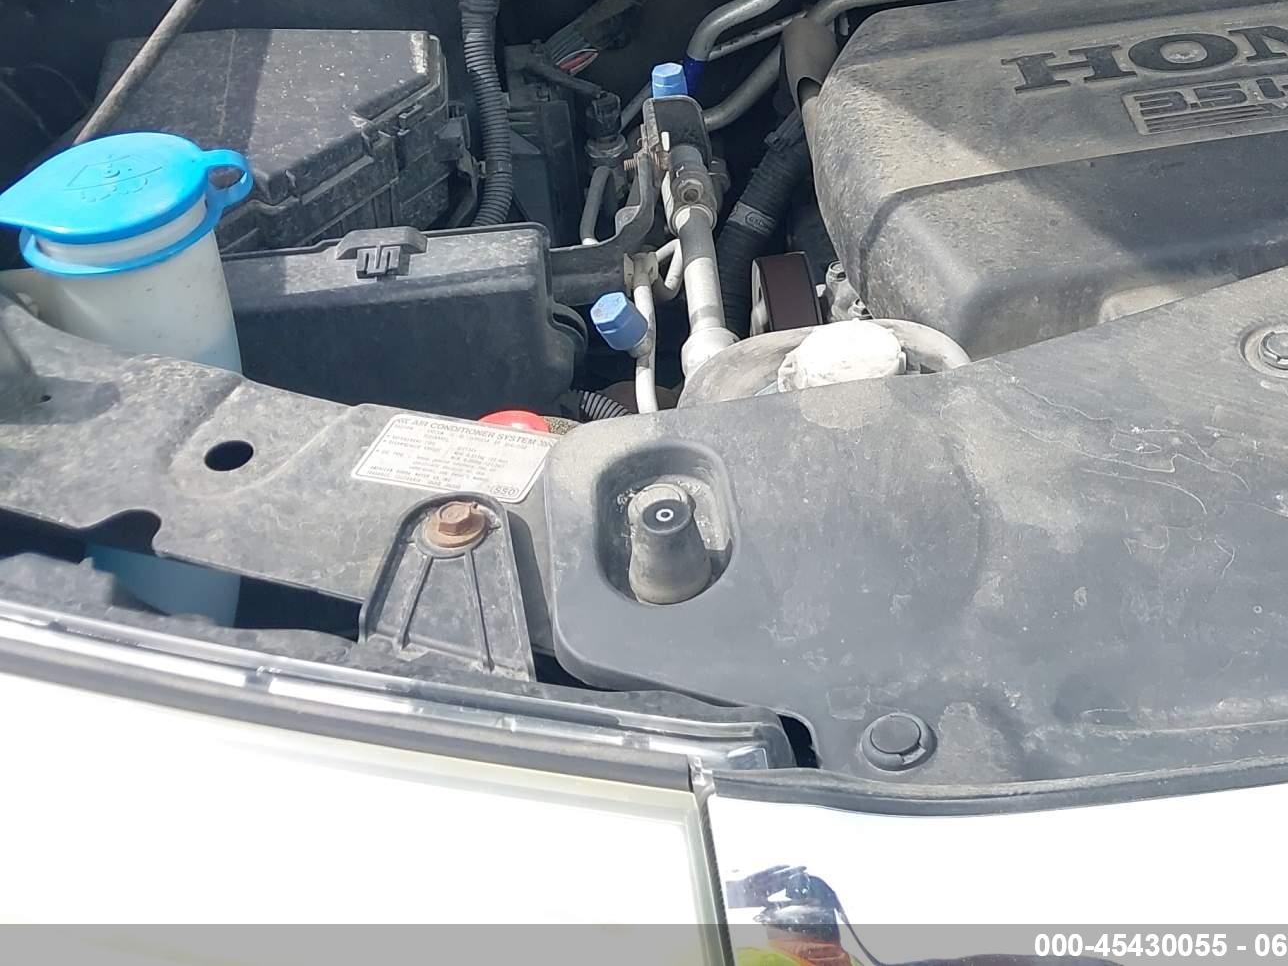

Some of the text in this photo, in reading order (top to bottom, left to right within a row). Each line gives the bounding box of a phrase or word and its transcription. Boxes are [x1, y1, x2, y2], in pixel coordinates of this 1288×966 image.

[1134, 83, 1250, 117] 3.5
[430, 421, 497, 440] CONDITIONER
[497, 432, 537, 446] SYSTEM
